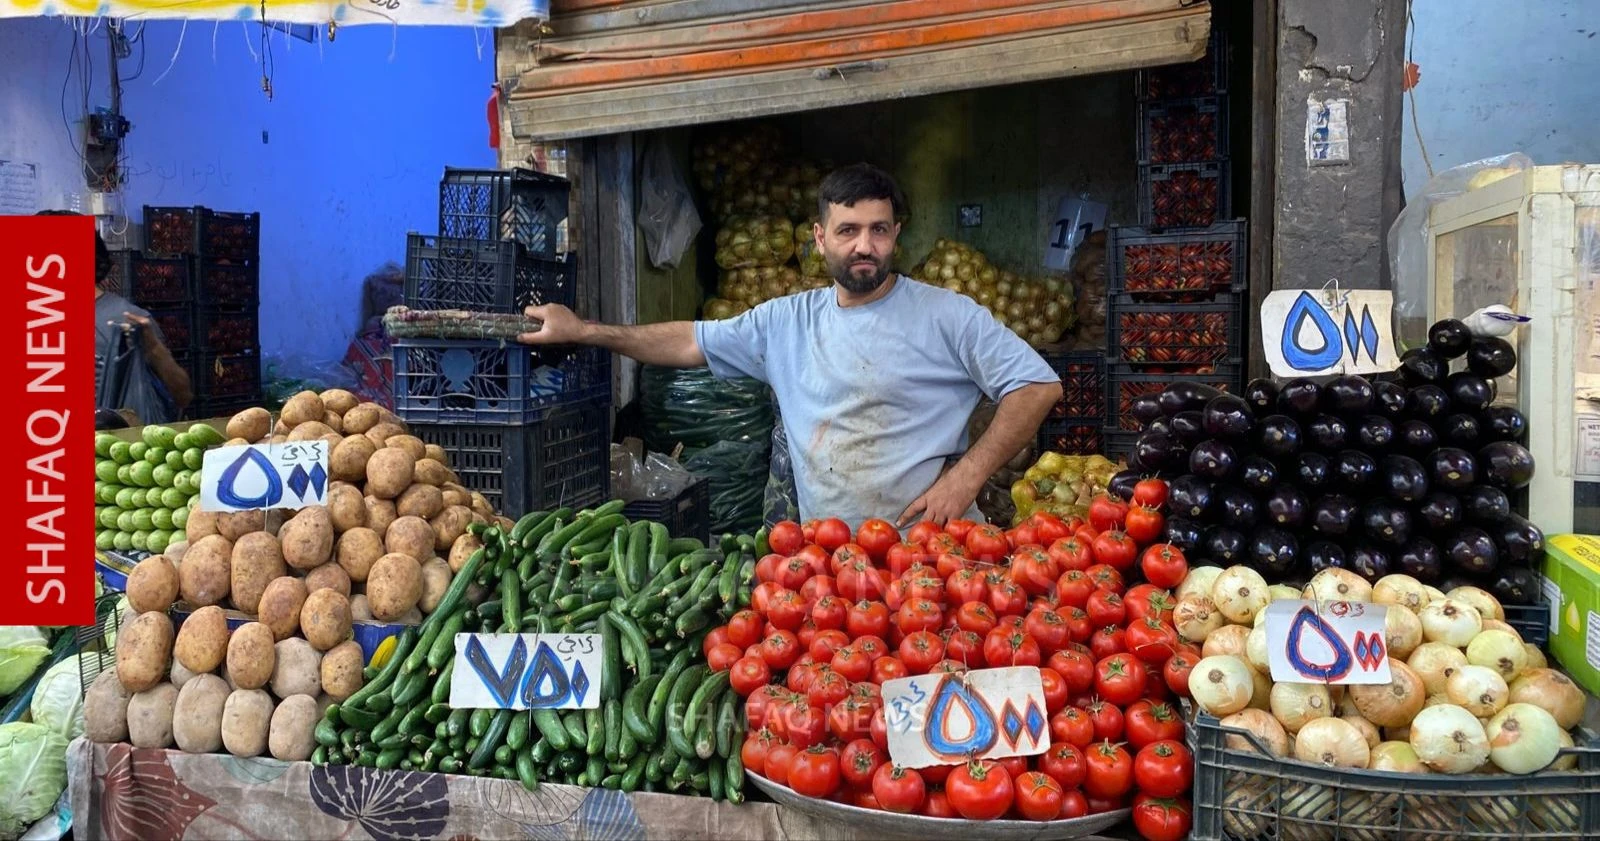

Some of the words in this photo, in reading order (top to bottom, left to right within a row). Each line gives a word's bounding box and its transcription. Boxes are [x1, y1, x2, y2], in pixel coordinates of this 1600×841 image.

[1281, 290, 1379, 371] ٥٠٠
[216, 446, 328, 509] ٥٠٠
[464, 633, 590, 708] ٧٥٠
[1285, 605, 1386, 682] ٥٠٠
[922, 671, 1046, 762] ٥٠٠
